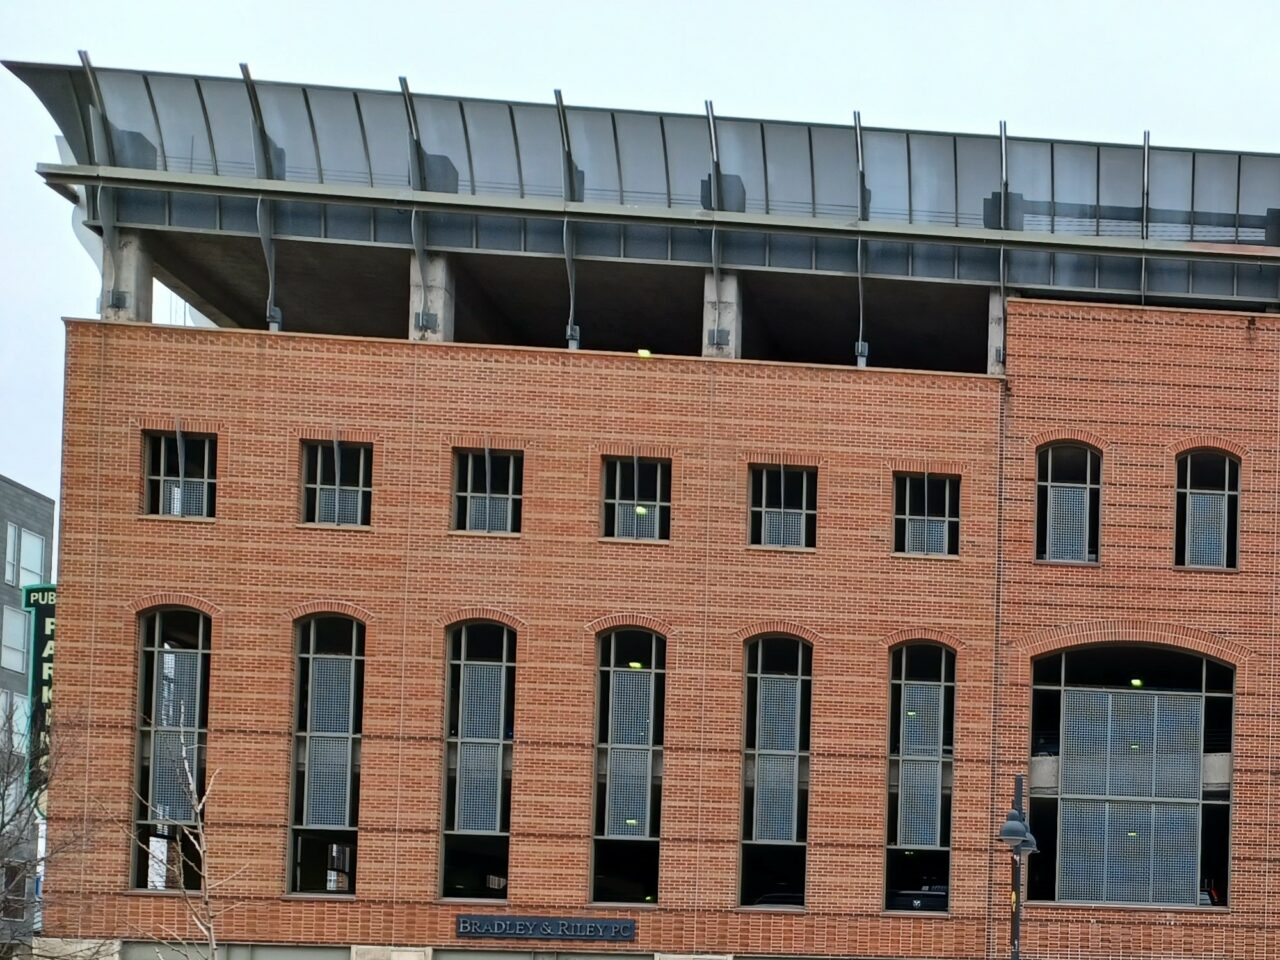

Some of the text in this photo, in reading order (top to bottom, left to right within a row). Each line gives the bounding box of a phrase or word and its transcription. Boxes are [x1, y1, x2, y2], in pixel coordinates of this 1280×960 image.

[30, 592, 57, 604] PUB
[459, 918, 631, 936] BRADLEY & RILEY PC
